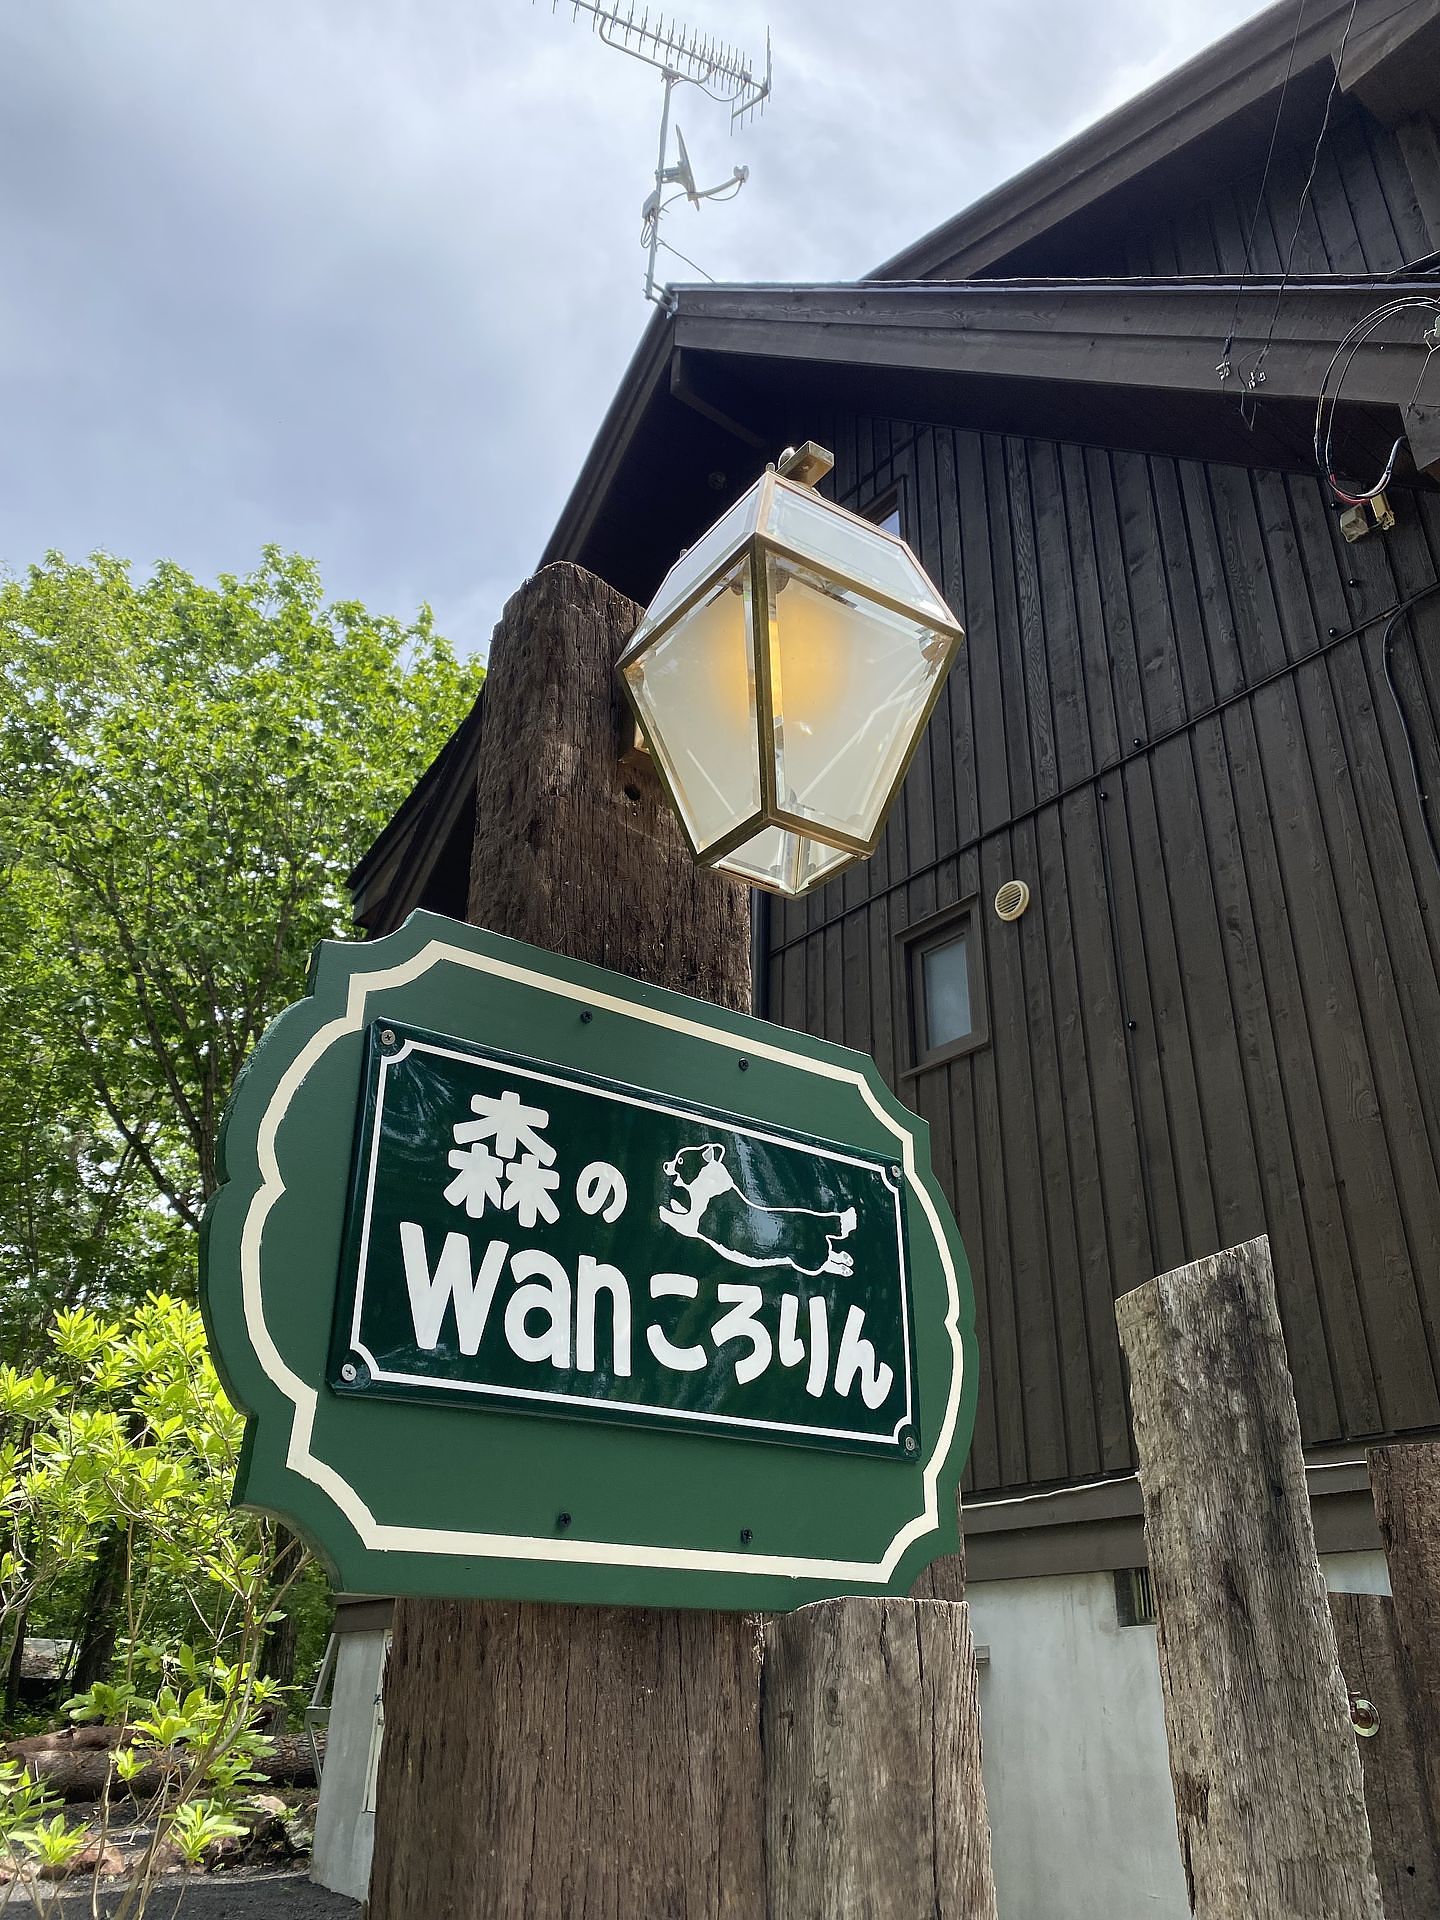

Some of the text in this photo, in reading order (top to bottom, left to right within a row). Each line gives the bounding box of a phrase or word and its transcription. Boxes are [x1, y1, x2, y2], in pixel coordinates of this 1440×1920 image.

[444, 1091, 627, 1227] 森の
[400, 1222, 893, 1409] Wanころりん
